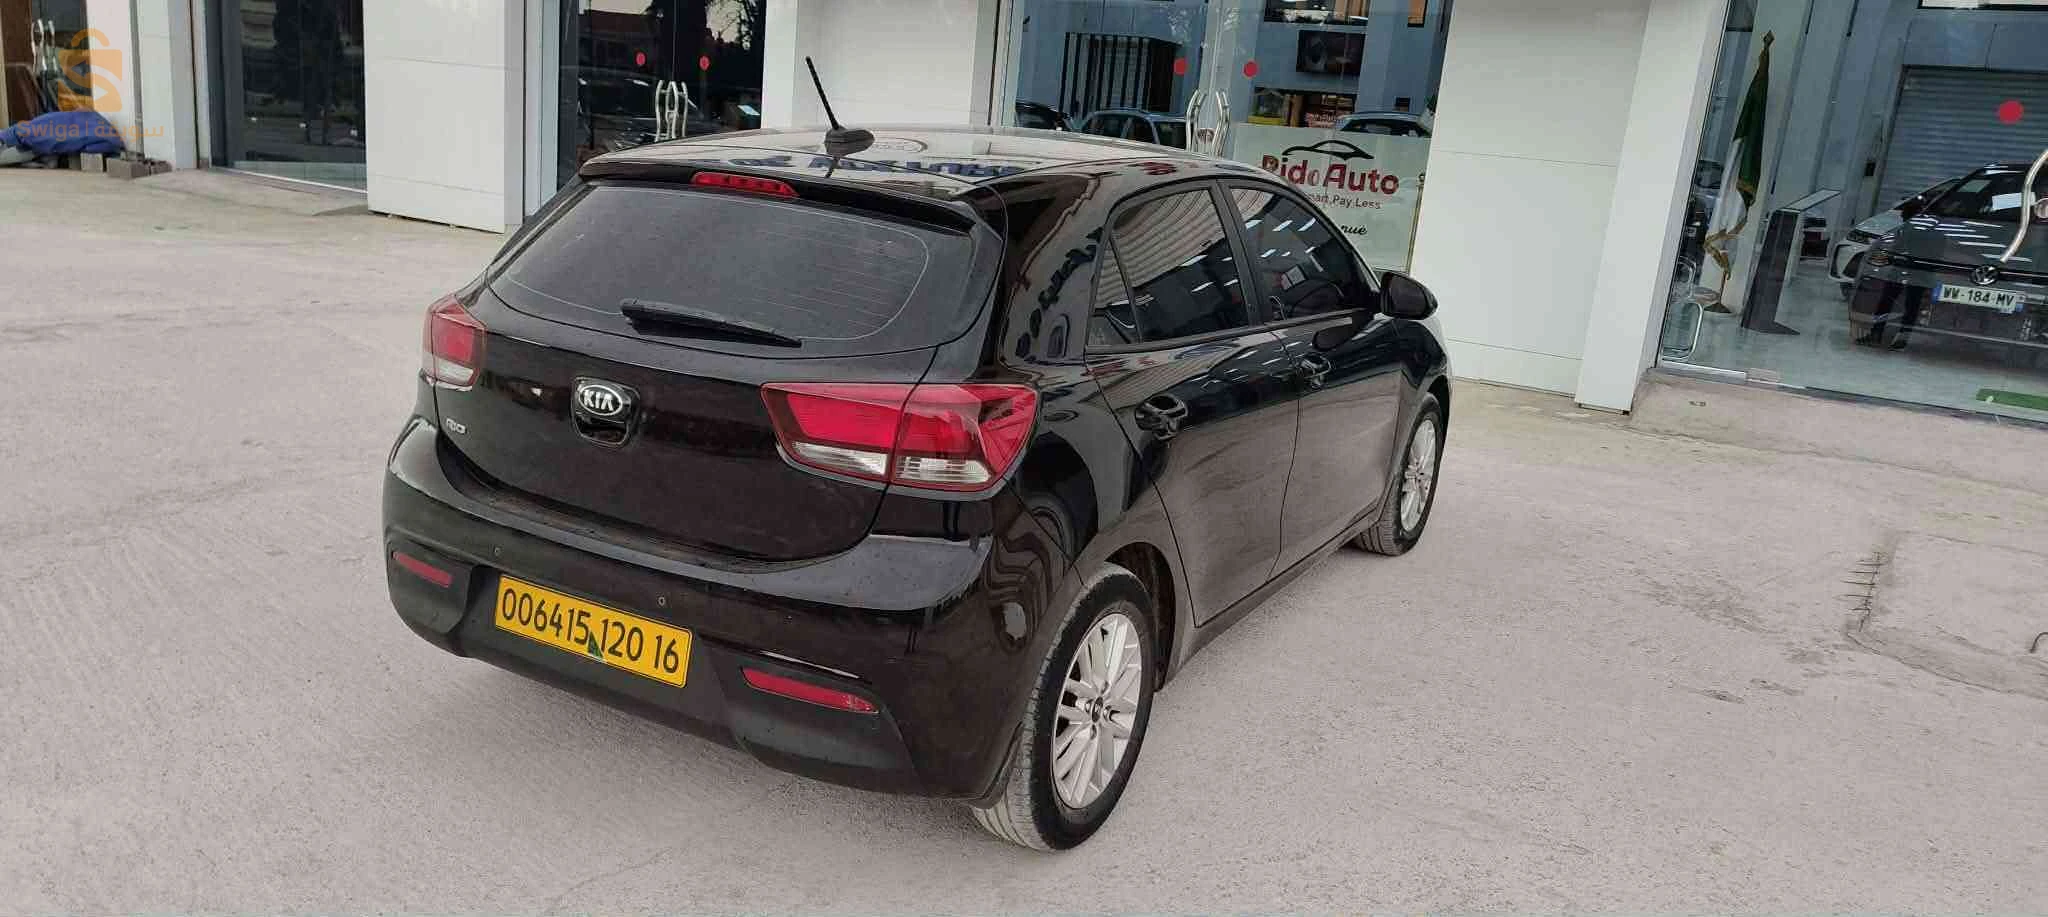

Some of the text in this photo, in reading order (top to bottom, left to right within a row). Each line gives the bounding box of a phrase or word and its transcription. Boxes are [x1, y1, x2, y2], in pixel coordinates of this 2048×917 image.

[1323, 163, 1399, 195] Auto
[582, 389, 614, 411] KIA
[502, 588, 679, 673] 006415 120 16
